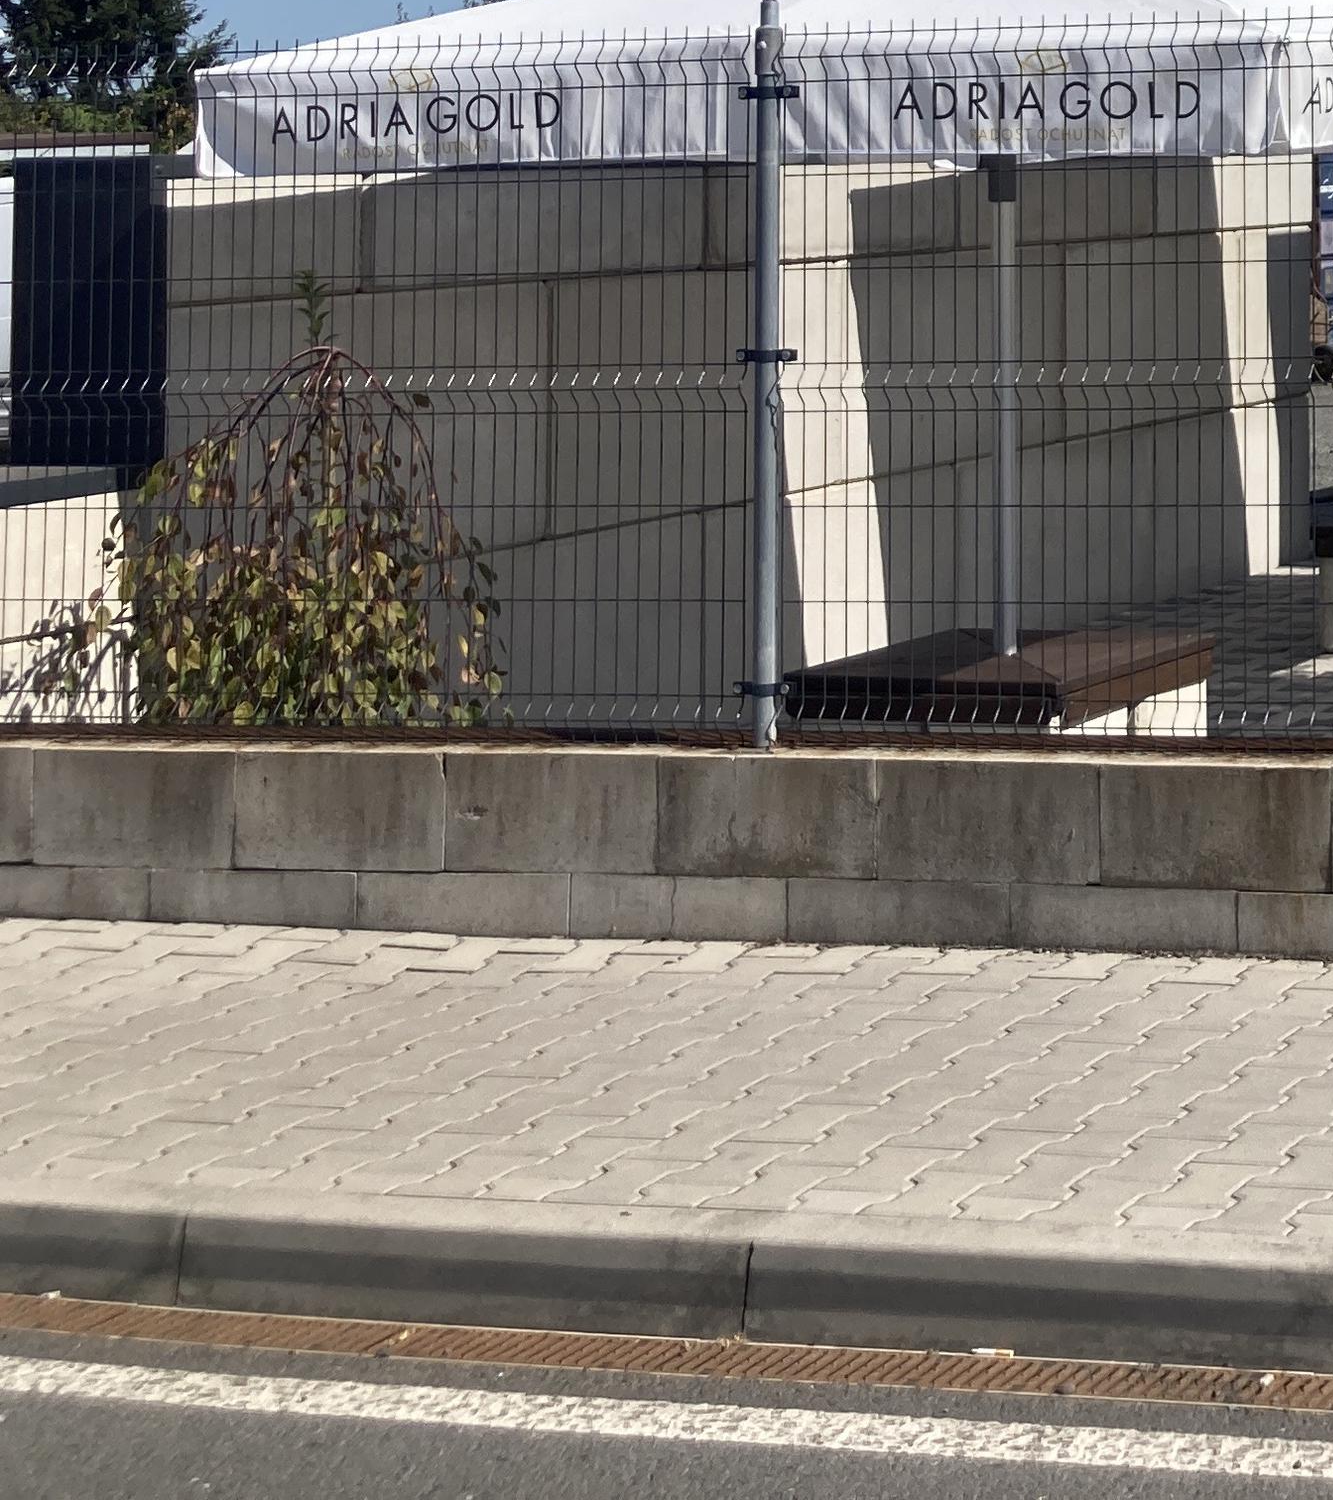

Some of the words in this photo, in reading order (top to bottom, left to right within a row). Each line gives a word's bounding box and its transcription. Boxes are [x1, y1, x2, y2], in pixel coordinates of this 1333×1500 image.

[271, 98, 414, 145] ADRIA
[426, 90, 562, 134] GOLD
[893, 81, 1045, 120] ADRIA
[1059, 80, 1202, 120] GOLD
